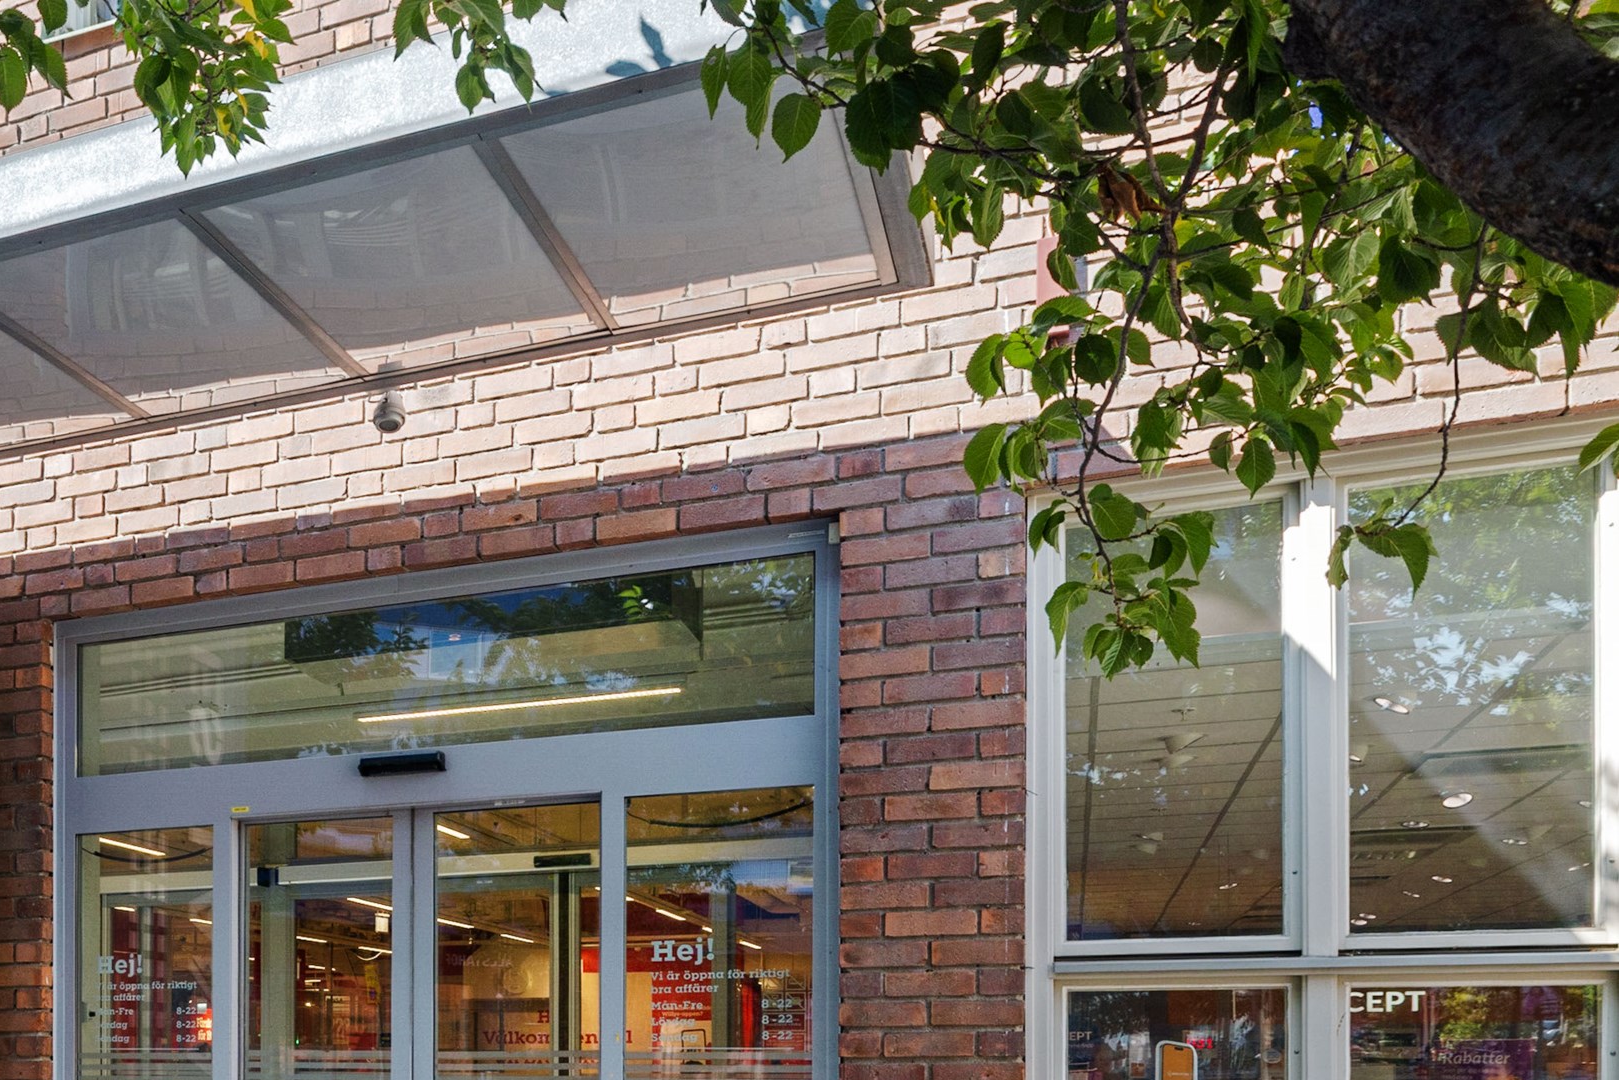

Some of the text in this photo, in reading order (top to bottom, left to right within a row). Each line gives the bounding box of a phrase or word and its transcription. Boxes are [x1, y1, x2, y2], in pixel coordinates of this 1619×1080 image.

[651, 937, 715, 965] Hej!
[97, 953, 143, 977] Hej!
[651, 968, 790, 983] Vi är öppna för riktigt
[151, 981, 166, 990] för
[167, 980, 198, 991] riktigt
[651, 983, 719, 994] bra affärer
[651, 1000, 703, 1011] Mån-Fre
[1442, 1051, 1511, 1066] Rabatter
